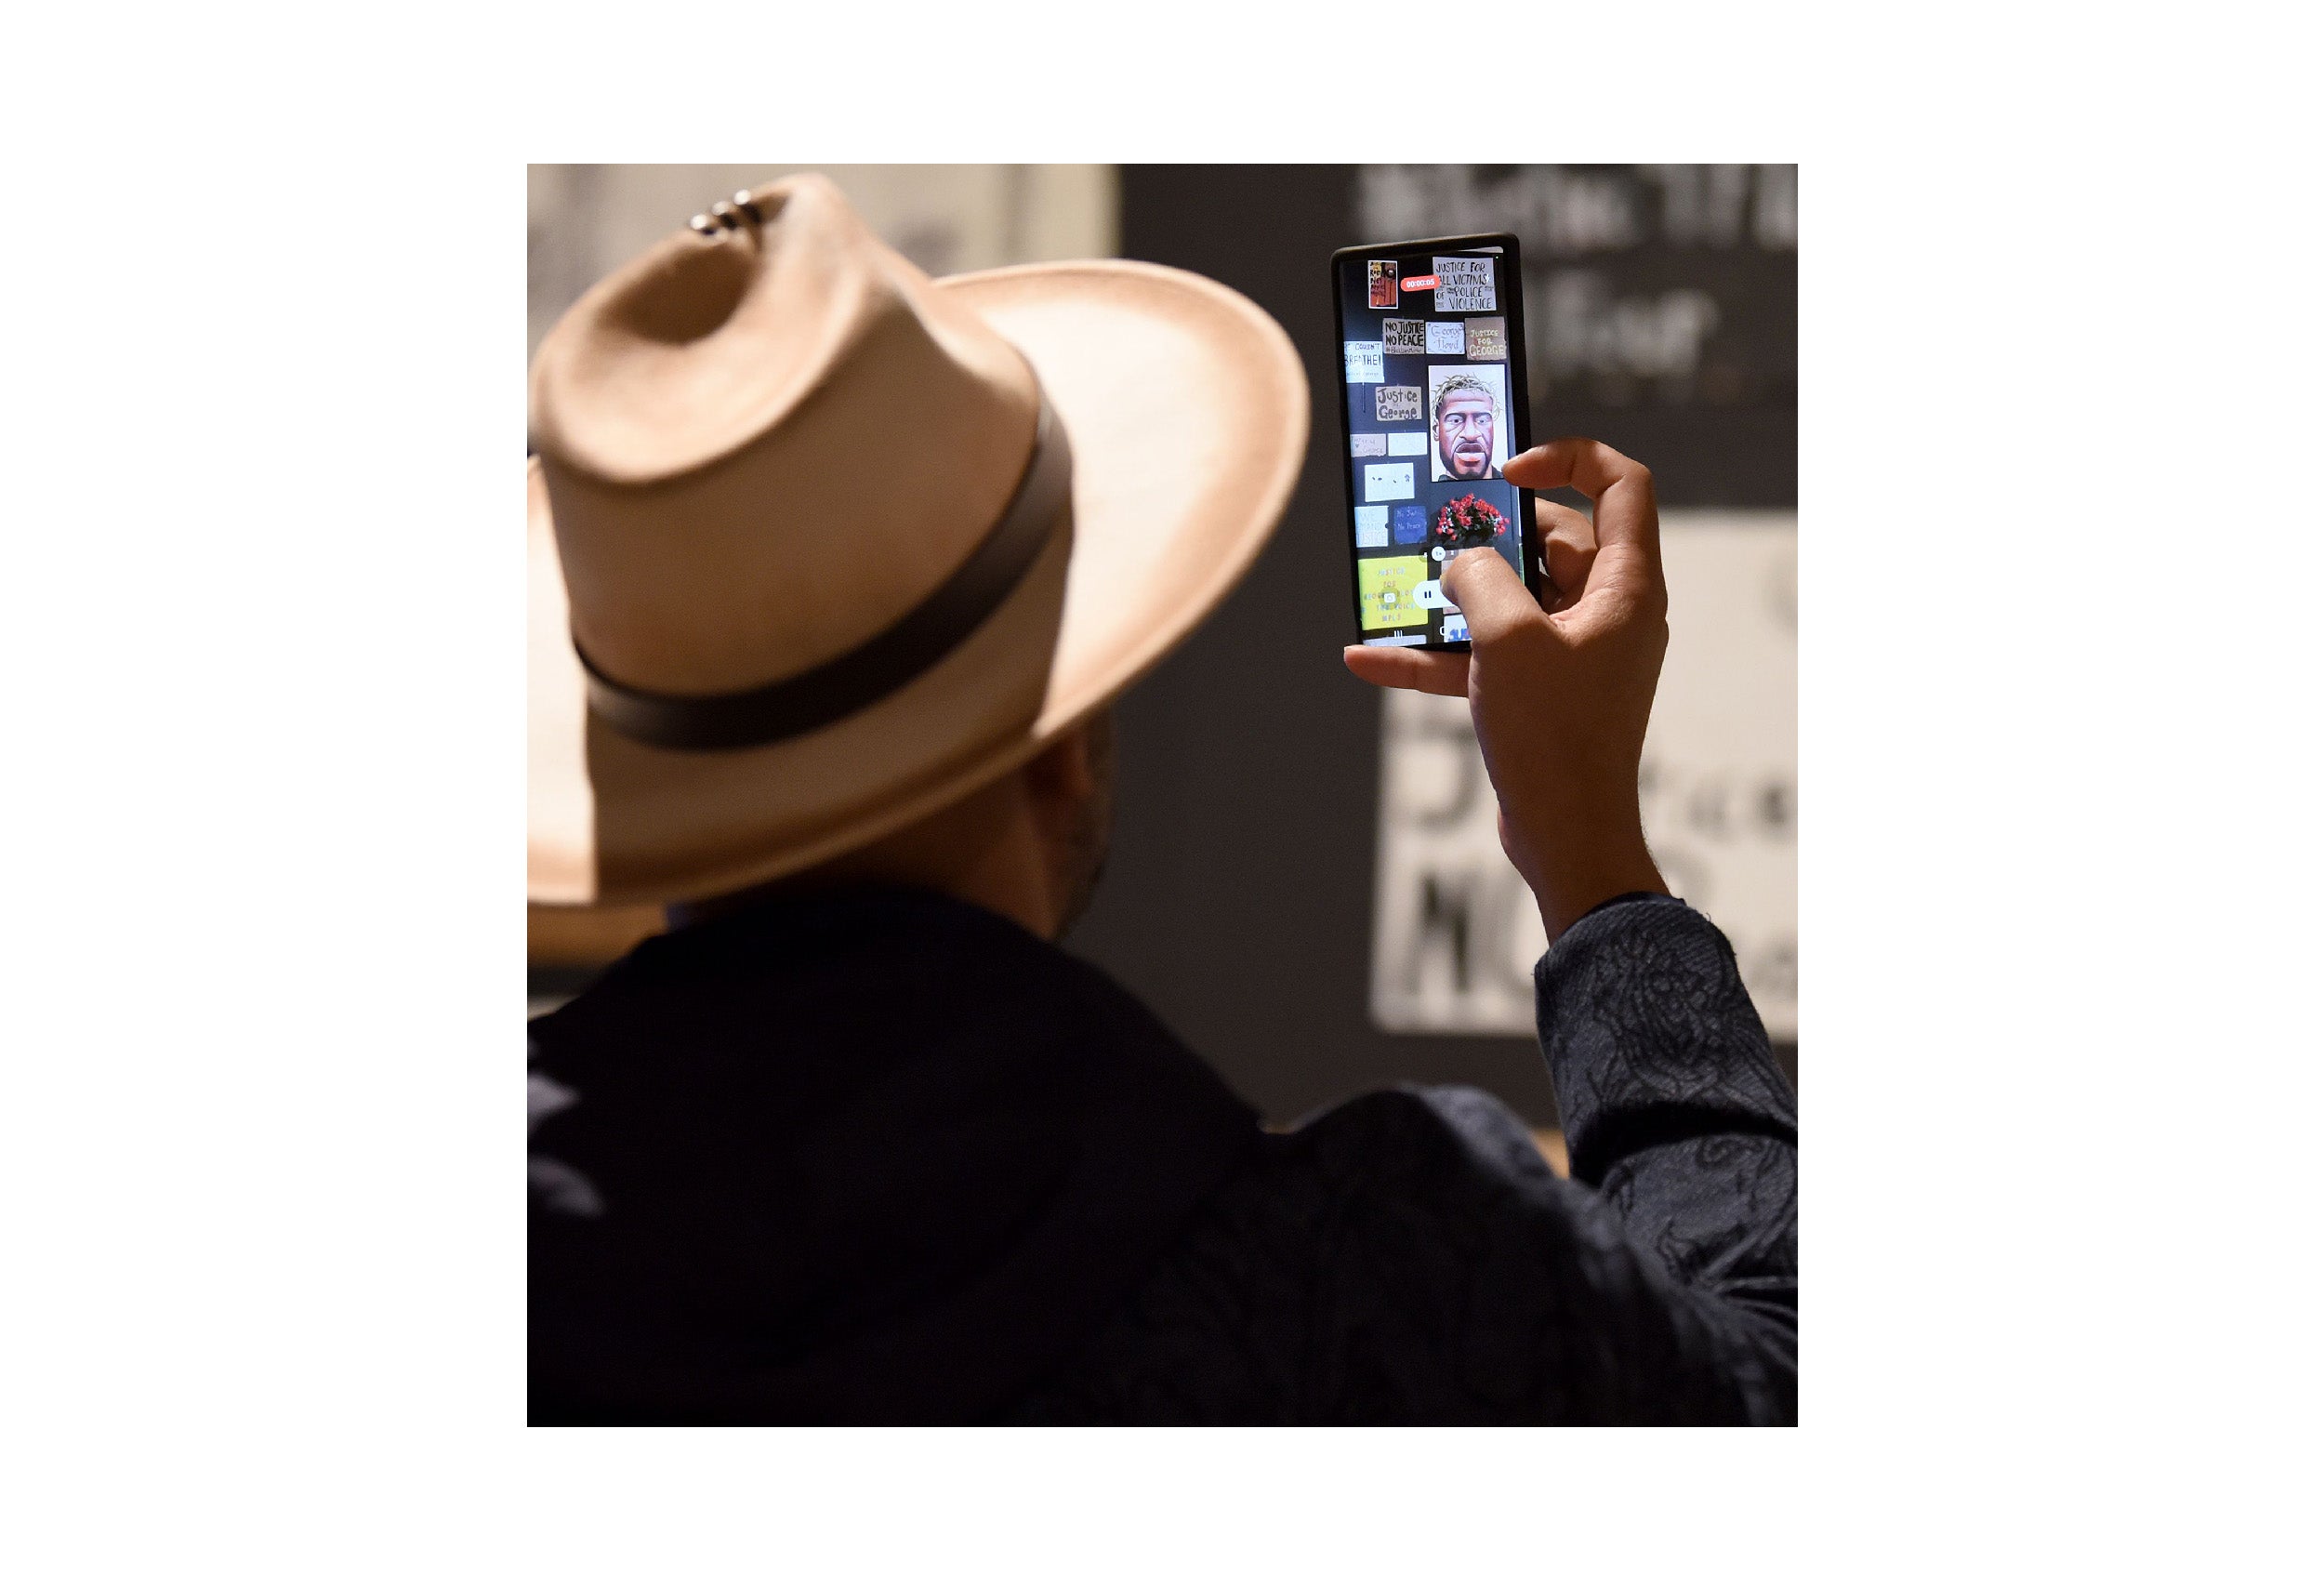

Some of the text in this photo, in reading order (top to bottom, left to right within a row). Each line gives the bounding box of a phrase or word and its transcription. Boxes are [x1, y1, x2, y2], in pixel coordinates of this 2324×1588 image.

[1436, 261, 1486, 272] JUSTICE FOR
[1453, 273, 1487, 285] VICTIMS
[1436, 291, 1445, 299] OF
[1455, 286, 1483, 297] POLICE
[1449, 298, 1492, 310] VIOLENCE
[1385, 321, 1424, 334] NO JUSTICE
[1471, 329, 1499, 337] JUSTICE
[1385, 334, 1424, 347] NO PEACE
[1470, 344, 1505, 357] GEORGE
[1378, 388, 1418, 404] Justice
[1379, 405, 1418, 419] George
